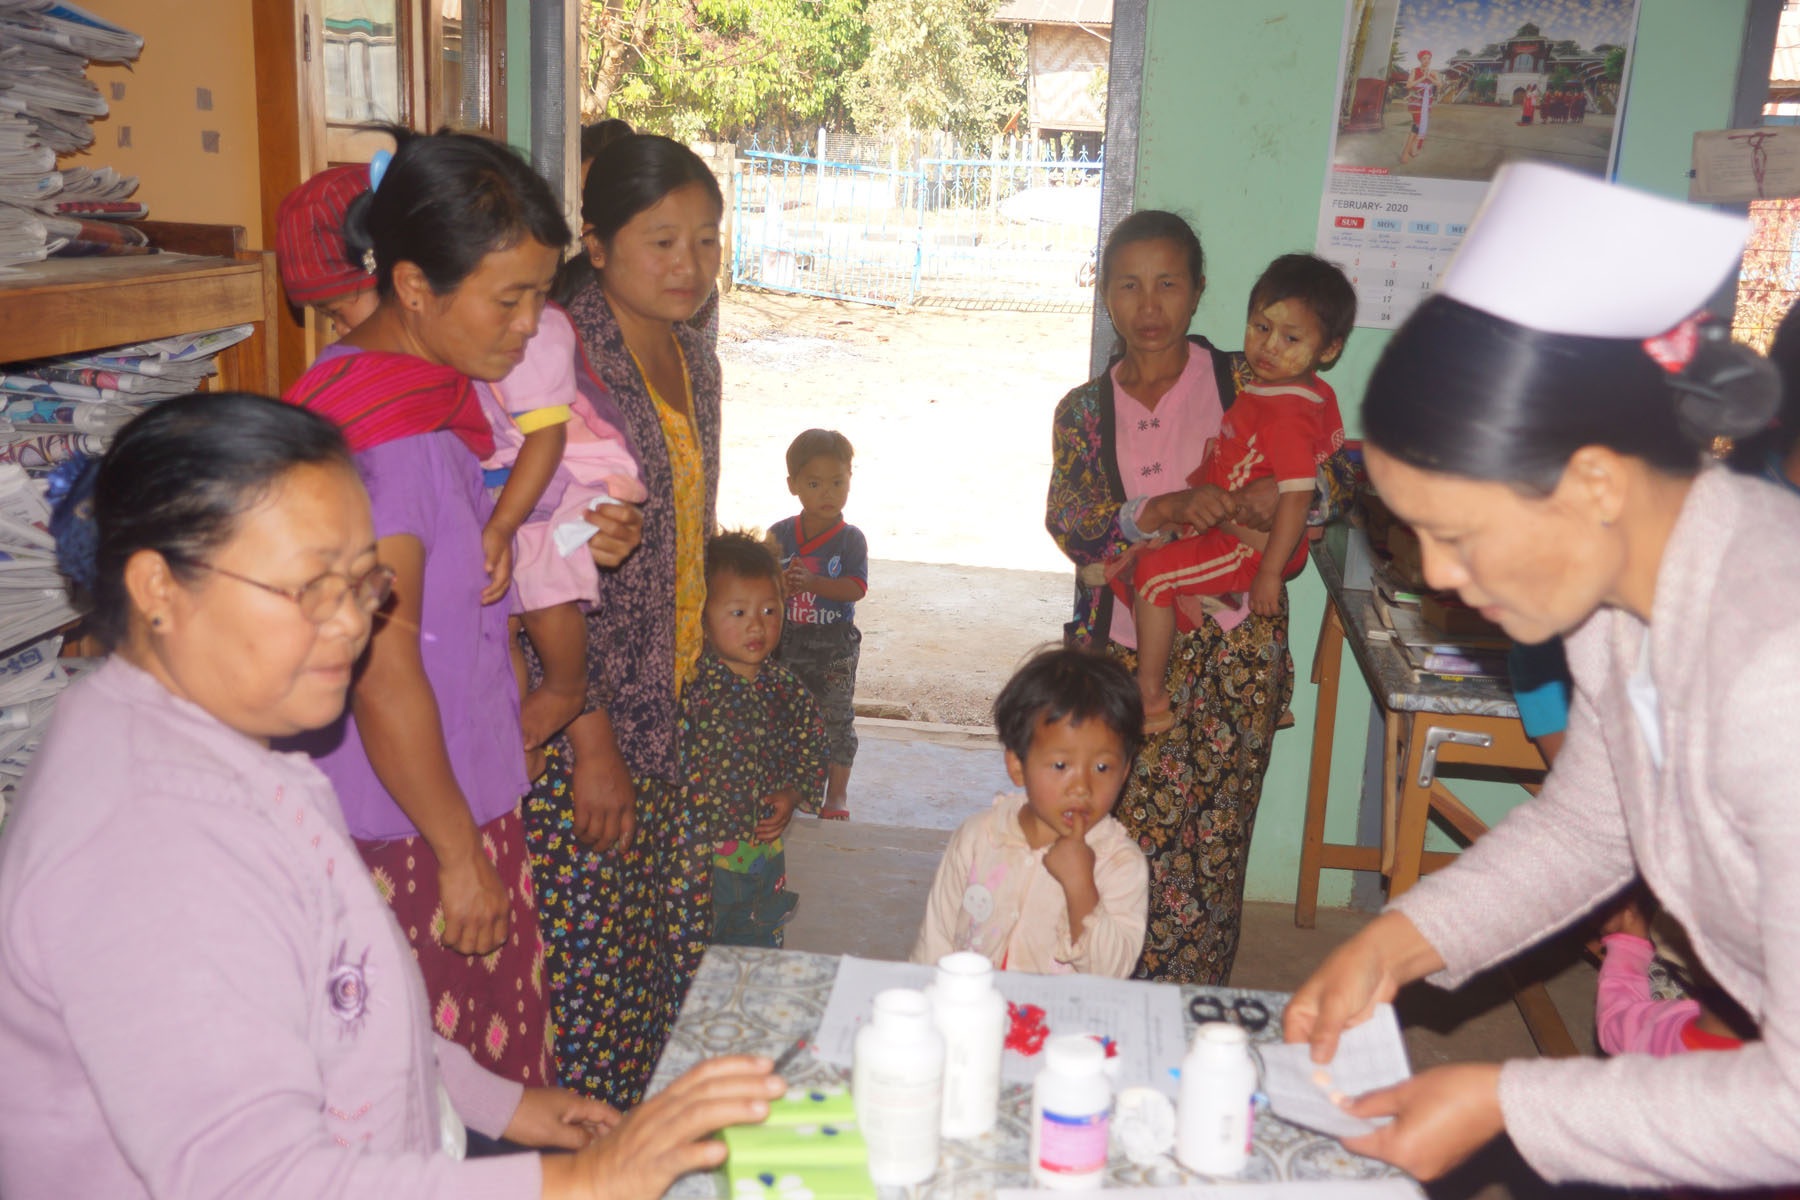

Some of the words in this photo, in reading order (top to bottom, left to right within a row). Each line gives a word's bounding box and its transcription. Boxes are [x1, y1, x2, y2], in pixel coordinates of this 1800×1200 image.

[1386, 203, 1409, 213] 2020
[1341, 218, 1358, 227] SUN
[1376, 221, 1396, 229] MON
[1416, 223, 1431, 232] TUE
[1384, 279, 1394, 287] 10
[1421, 281, 1431, 290] 11
[1383, 295, 1392, 303] 17
[1381, 312, 1391, 321] 24
